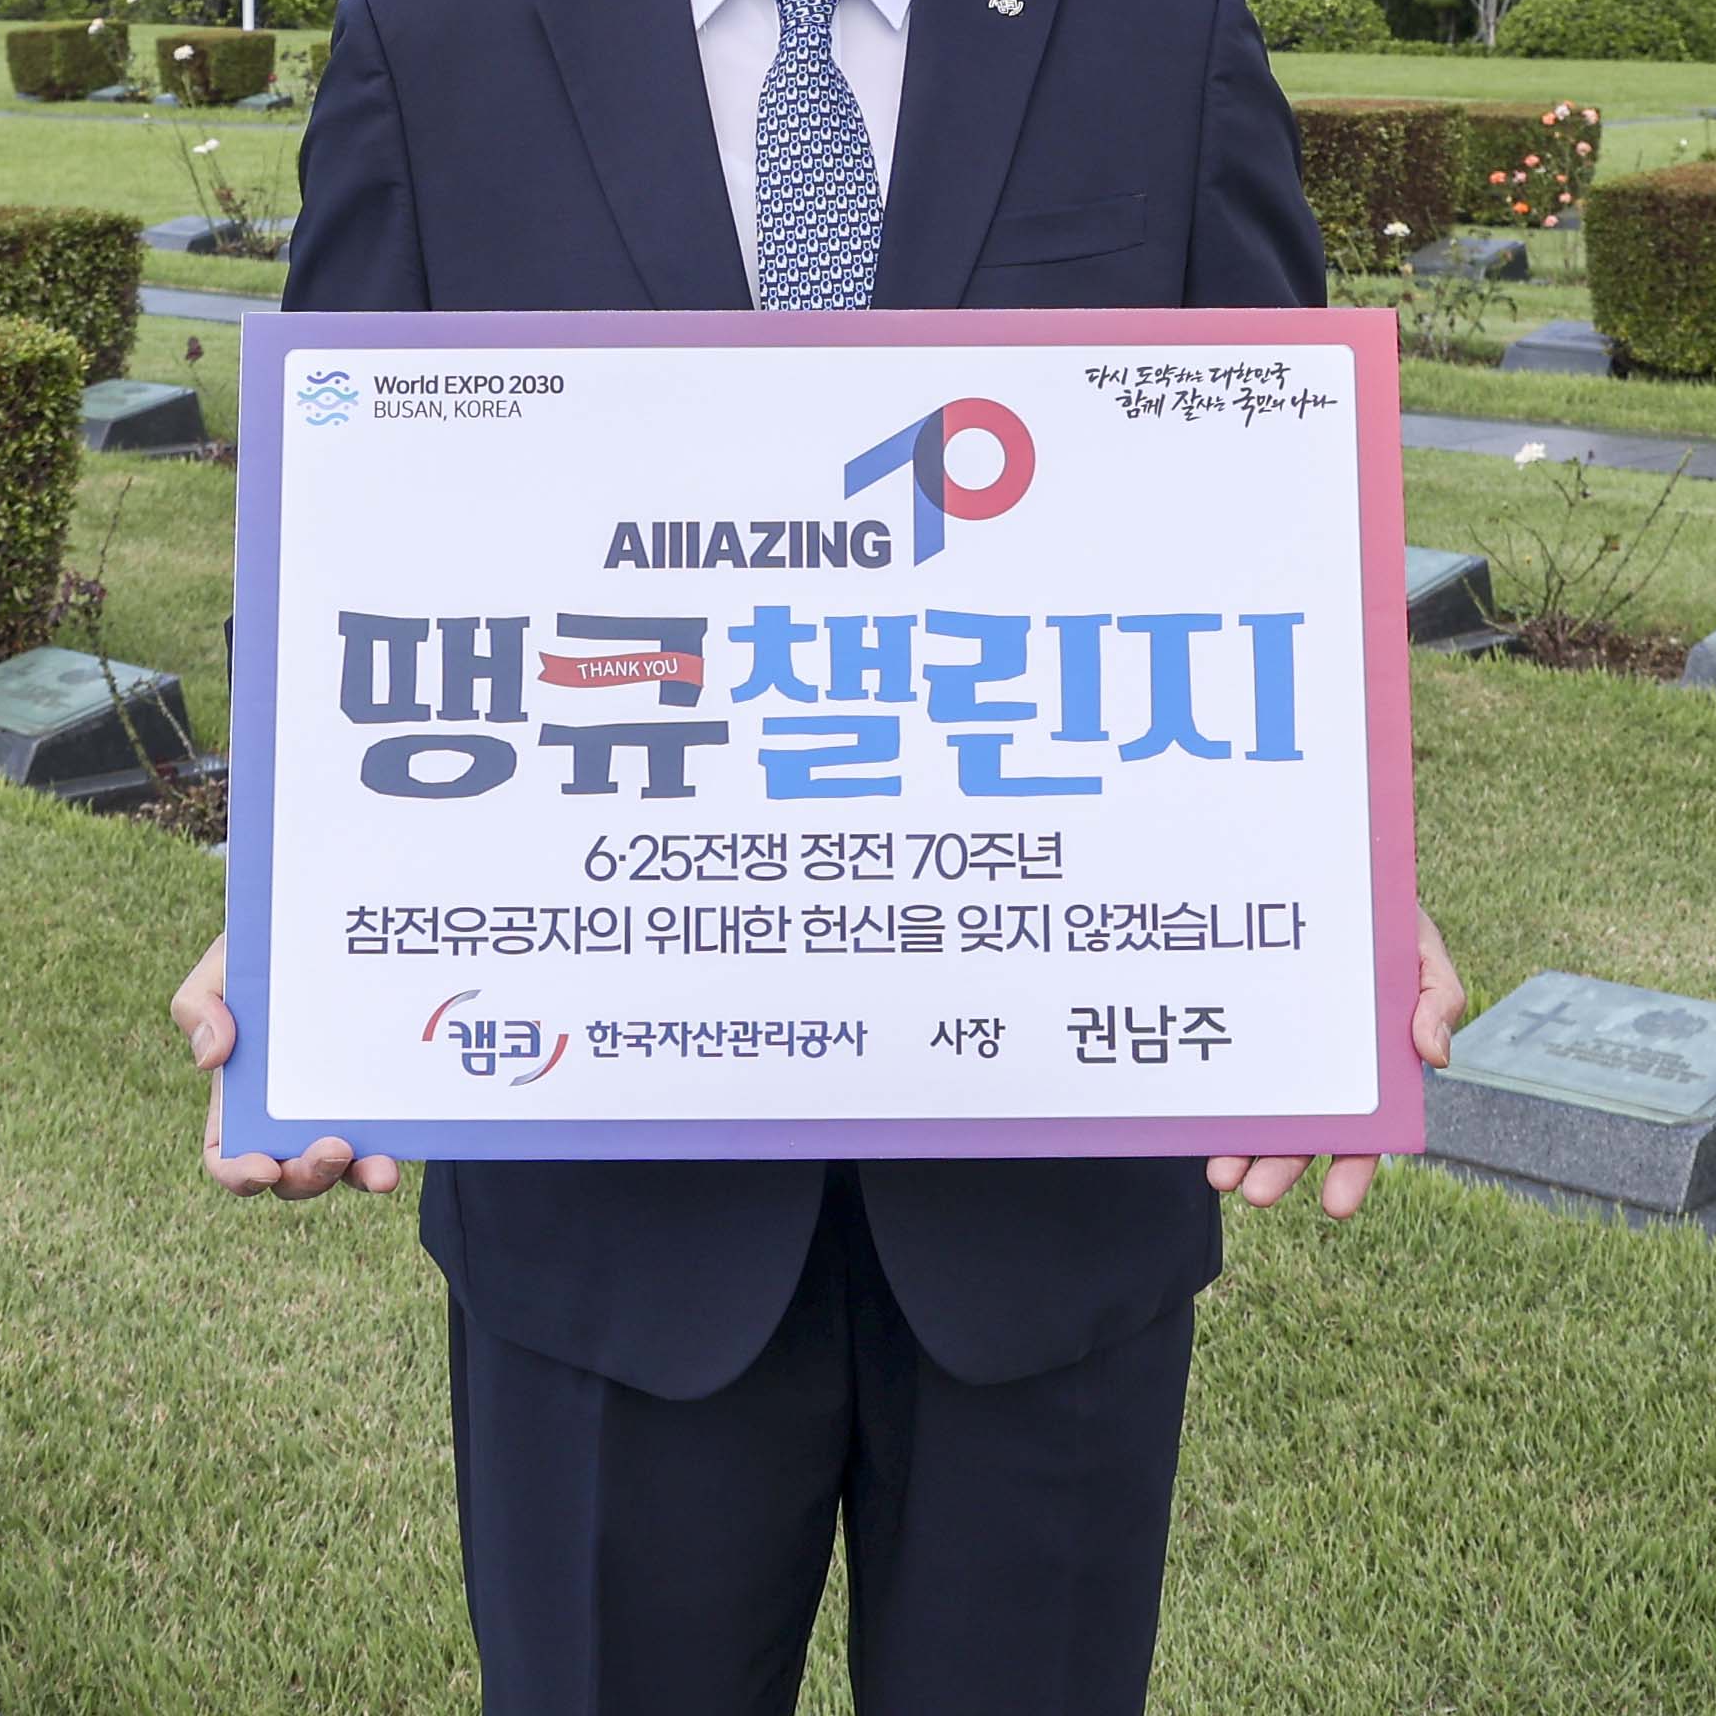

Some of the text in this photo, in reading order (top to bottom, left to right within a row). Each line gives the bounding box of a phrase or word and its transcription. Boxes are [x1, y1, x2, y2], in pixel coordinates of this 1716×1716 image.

[373, 374, 565, 395] World EXPO 2030
[1084, 361, 1292, 391] 다시 도약하는 대한민국
[373, 399, 523, 422] BUSAN, KOREA
[1114, 388, 1167, 420] 함께
[1231, 386, 1287, 429] 국민의
[1290, 387, 1339, 420] 나라
[576, 657, 679, 680] THANK YOU
[800, 832, 895, 882] 정전
[904, 831, 1064, 882] 70주년
[344, 901, 1307, 957] 참전유공자의 위대한 헌신을 잊지 않겠습니다
[448, 1004, 1233, 1077] 캠코 한국자산관리공사 사장 권남주
